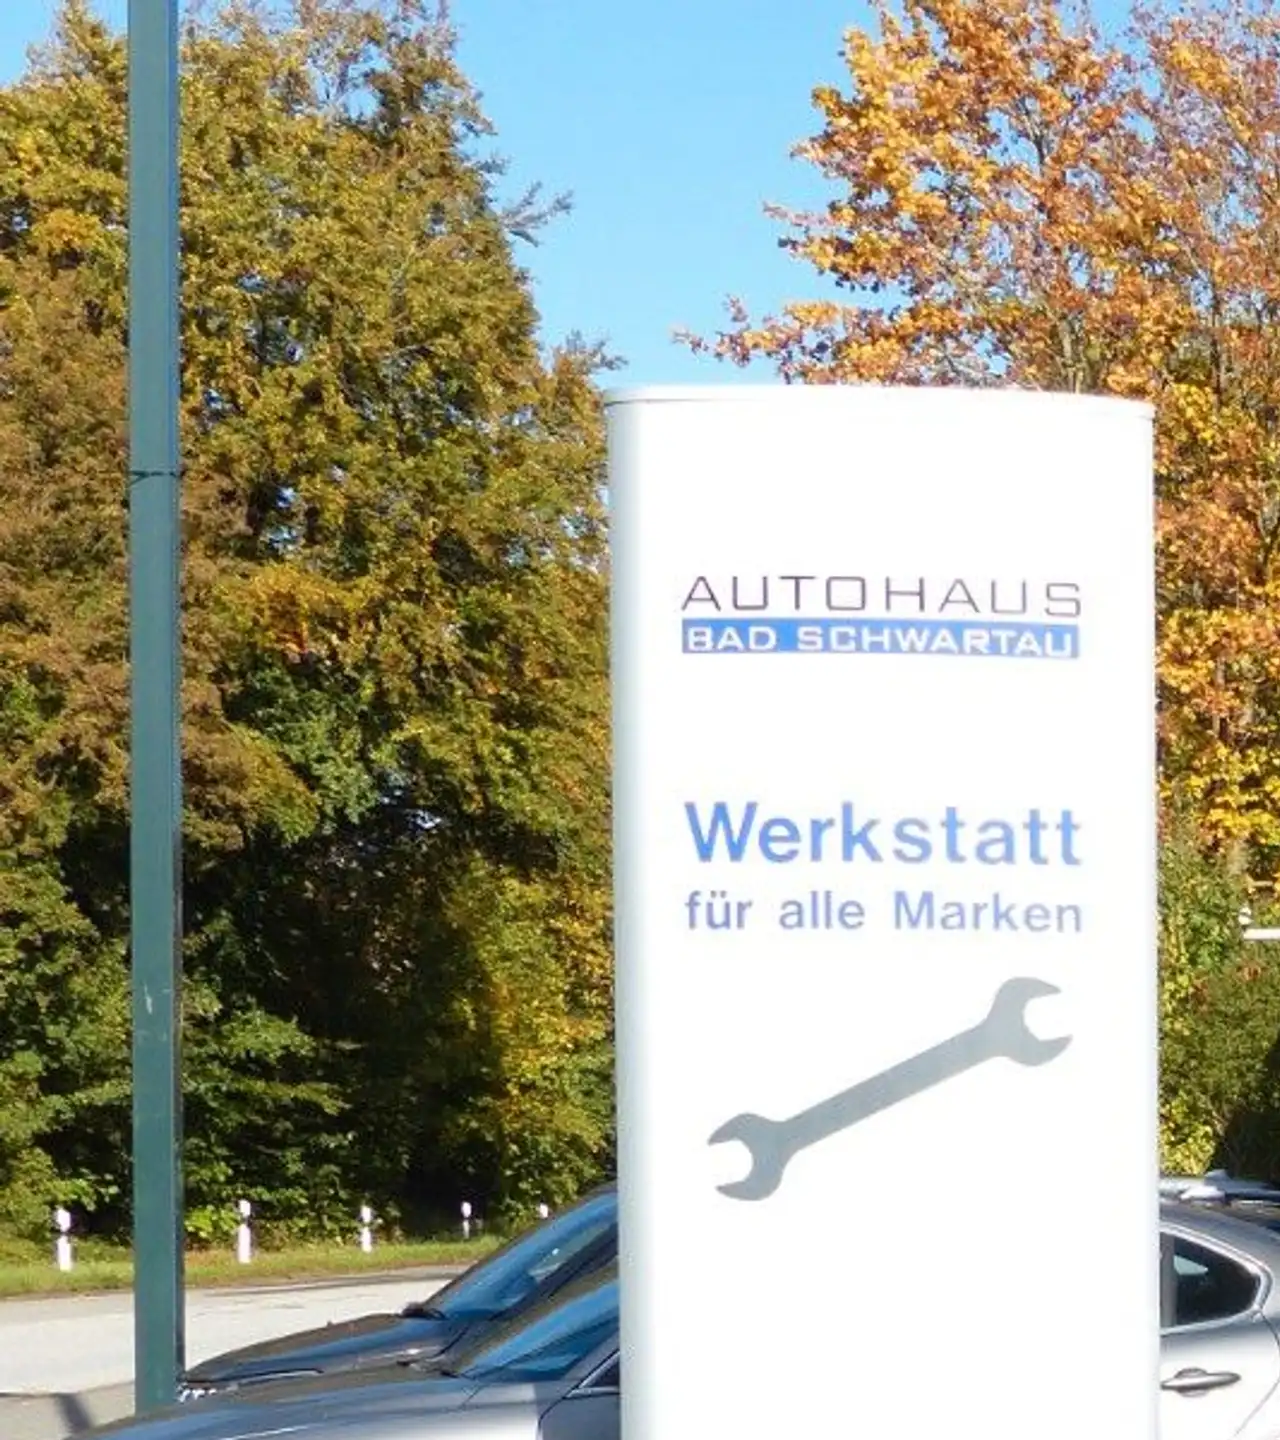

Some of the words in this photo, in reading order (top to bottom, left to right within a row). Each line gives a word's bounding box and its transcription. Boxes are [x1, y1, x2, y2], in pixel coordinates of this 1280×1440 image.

[681, 575, 1081, 618] AUTOHAUS
[687, 626, 778, 652] BAD
[797, 626, 1073, 657] SCHWARTAU
[684, 801, 1081, 866] Werkstatt
[684, 890, 753, 930] für
[779, 890, 865, 930] alle
[894, 890, 1082, 933] Marken
